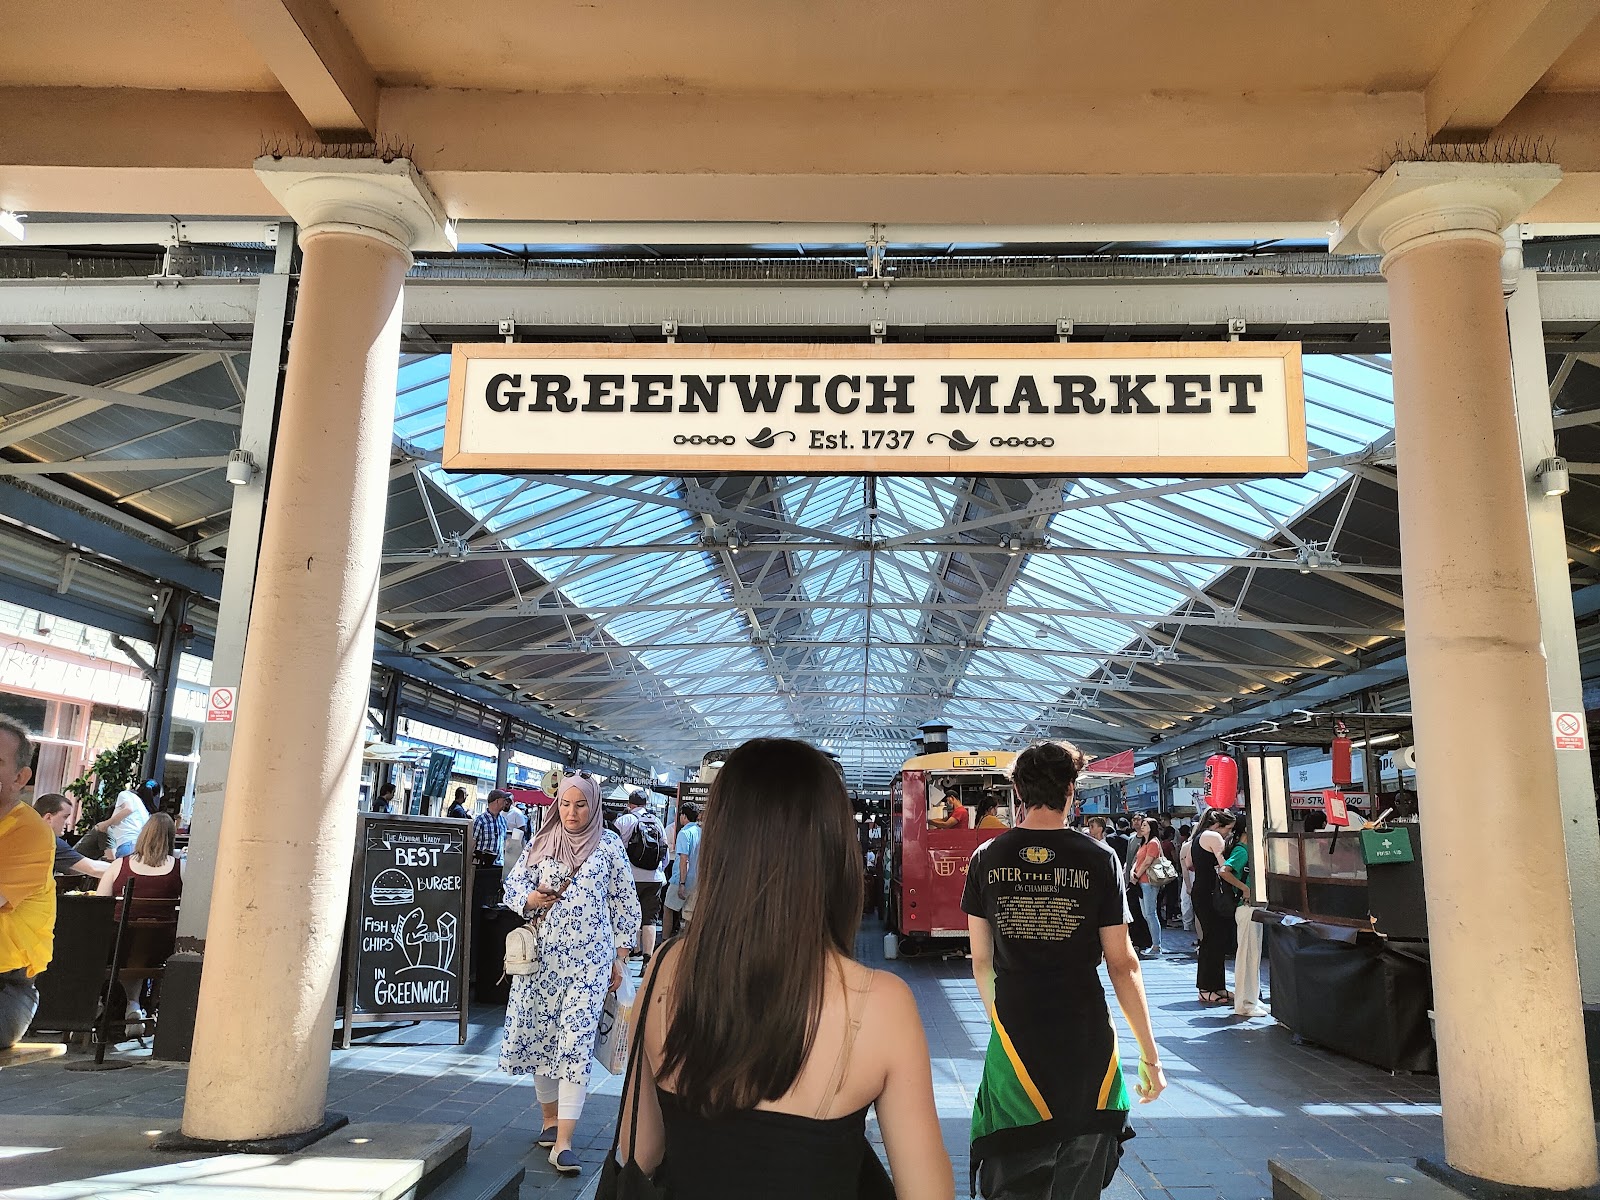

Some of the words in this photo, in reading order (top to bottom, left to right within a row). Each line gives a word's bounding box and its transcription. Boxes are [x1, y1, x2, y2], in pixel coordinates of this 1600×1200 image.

[485, 373, 915, 414] GREENWICH
[940, 374, 1263, 414] MARKET
[808, 429, 855, 450] Est.
[861, 429, 915, 450] 1737
[385, 833, 397, 842] THE
[422, 835, 442, 844] HARDY
[395, 847, 441, 867] BEST
[416, 875, 462, 891] BURGER
[988, 867, 1022, 885] ENTER
[1022, 872, 1052, 881] THE
[1053, 867, 1089, 890] WU-TANG
[364, 916, 389, 933] FISH
[363, 937, 394, 952] CHIPS
[374, 967, 386, 980] IN
[374, 979, 450, 1006] GREENWICH
